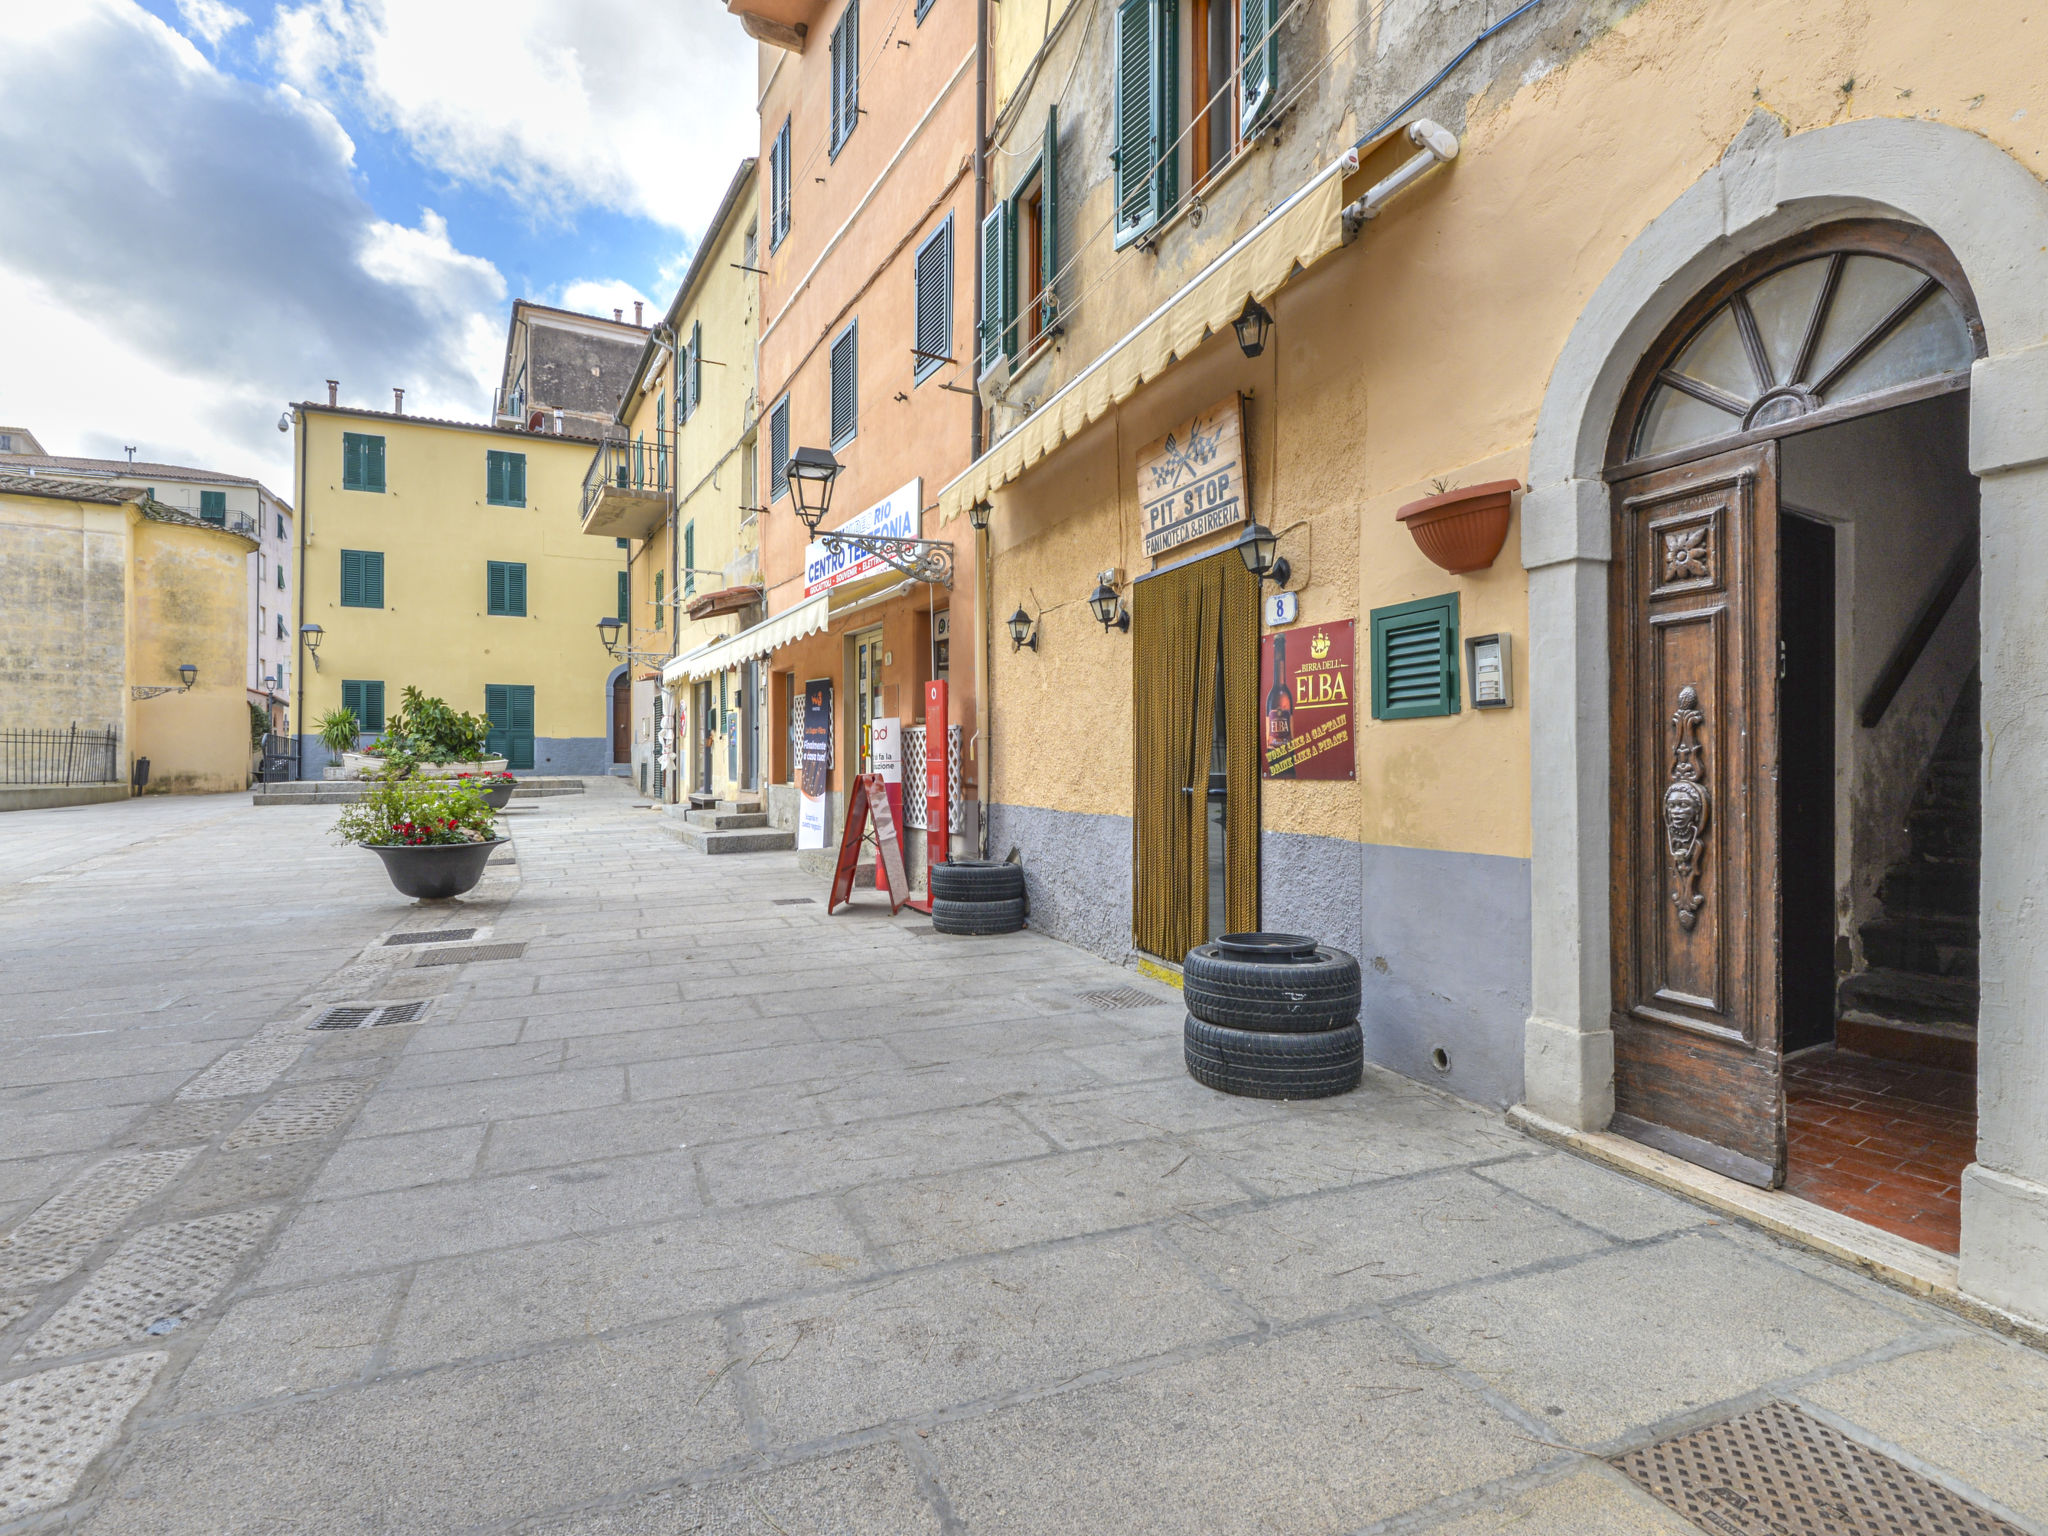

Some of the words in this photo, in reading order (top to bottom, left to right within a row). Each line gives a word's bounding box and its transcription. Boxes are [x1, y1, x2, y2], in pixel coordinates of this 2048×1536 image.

[874, 501, 891, 525] RIO
[1150, 499, 1175, 530] PIT
[1184, 473, 1230, 516] STOP
[1145, 523, 1190, 555] PANINOTECA
[808, 547, 845, 583] CENTRO
[1276, 599, 1284, 617] 8
[1301, 661, 1321, 673] BIRRA
[1322, 658, 1341, 670] DELL'
[1295, 671, 1348, 704] ELBA
[1265, 744, 1287, 762] WORK
[1287, 735, 1305, 752] LIKE
[1305, 732, 1312, 743] A
[1311, 713, 1347, 740] CAPTAIN
[1271, 720, 1289, 733] ELBA
[1269, 757, 1294, 776] DRINK
[1293, 748, 1312, 765] LIKE
[1312, 745, 1318, 757] A
[1317, 729, 1349, 753] PIRATE
